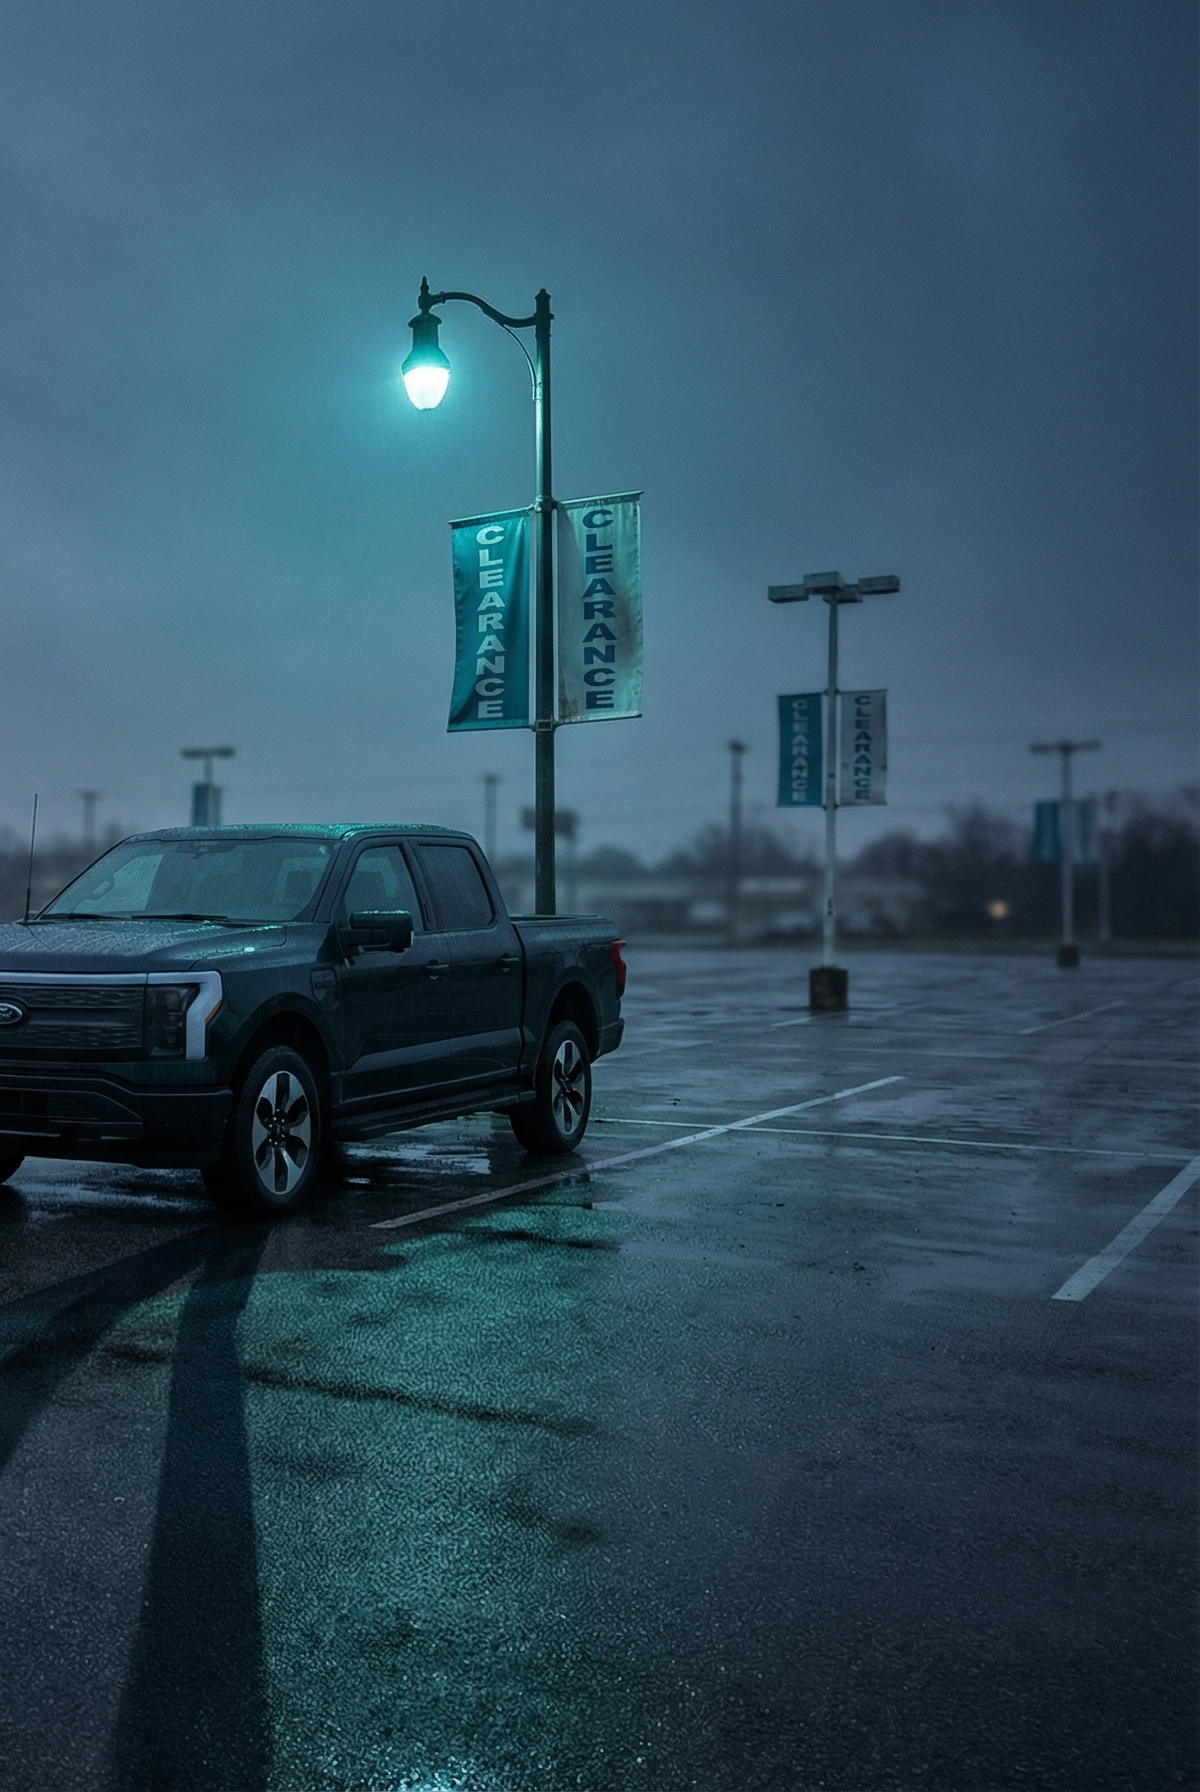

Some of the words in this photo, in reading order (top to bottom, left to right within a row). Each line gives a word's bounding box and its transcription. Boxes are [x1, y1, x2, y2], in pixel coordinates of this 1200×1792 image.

[475, 525, 506, 720] CLEARANCE
[581, 508, 618, 710] CLEARANCE
[792, 700, 810, 802] CLEARANCE
[854, 696, 872, 800] CLEARANCE
